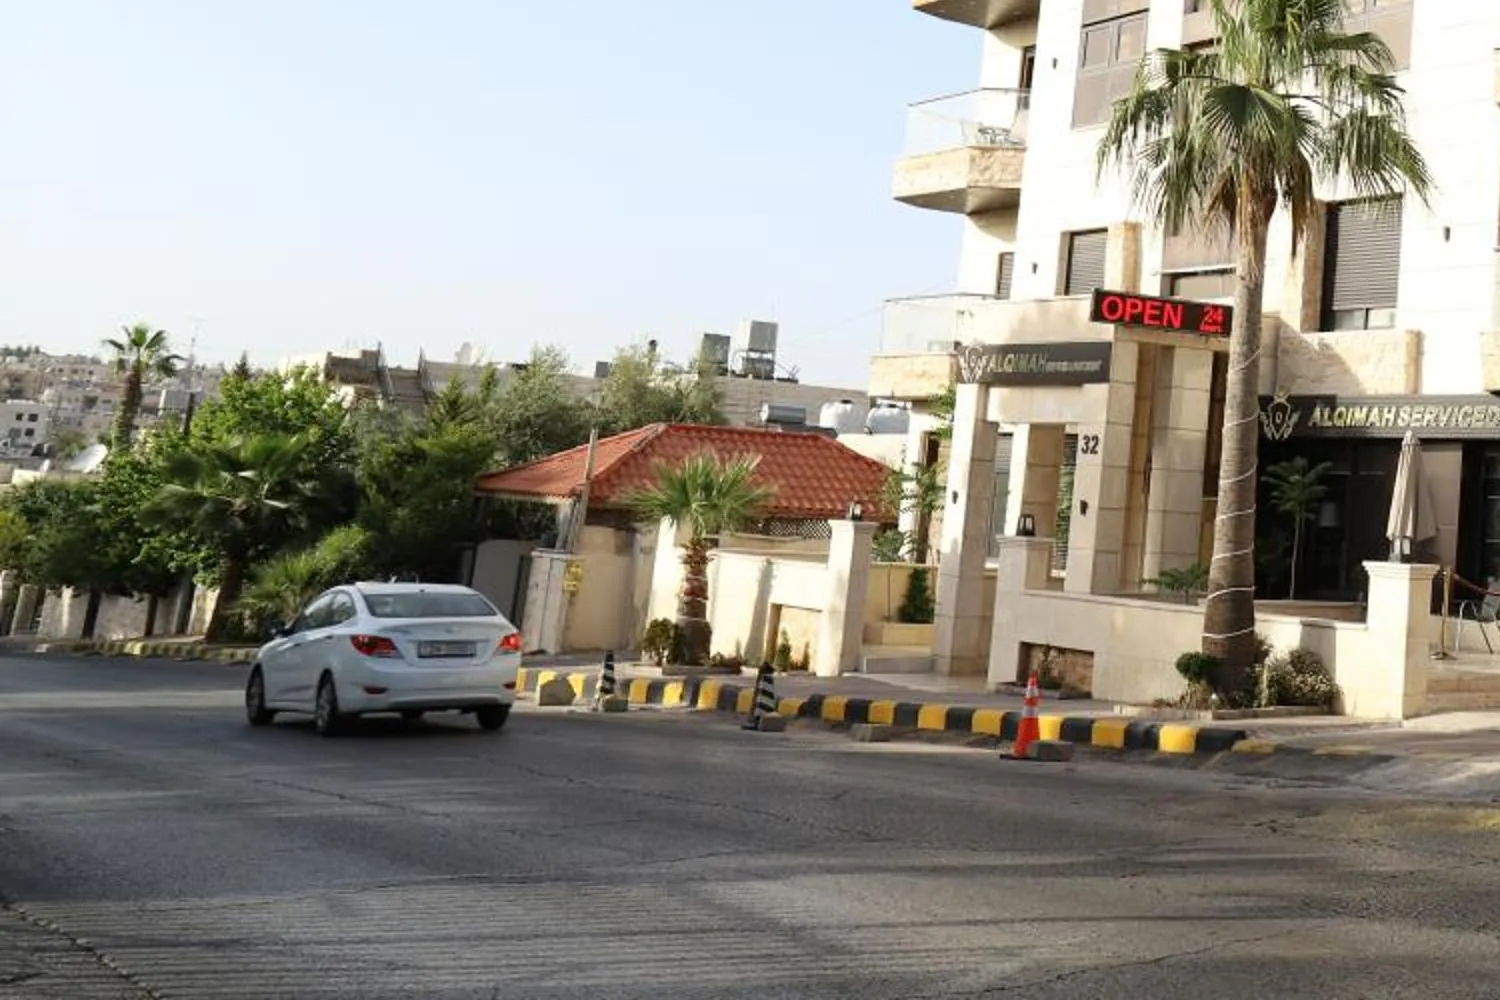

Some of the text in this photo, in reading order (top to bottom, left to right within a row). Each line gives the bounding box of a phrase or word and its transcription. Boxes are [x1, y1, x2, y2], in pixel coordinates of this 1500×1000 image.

[1102, 296, 1183, 328] OPEN
[1309, 405, 1395, 427] ALQIMAH
[1397, 405, 1500, 427] SERVICED
[1081, 434, 1100, 455] 32
